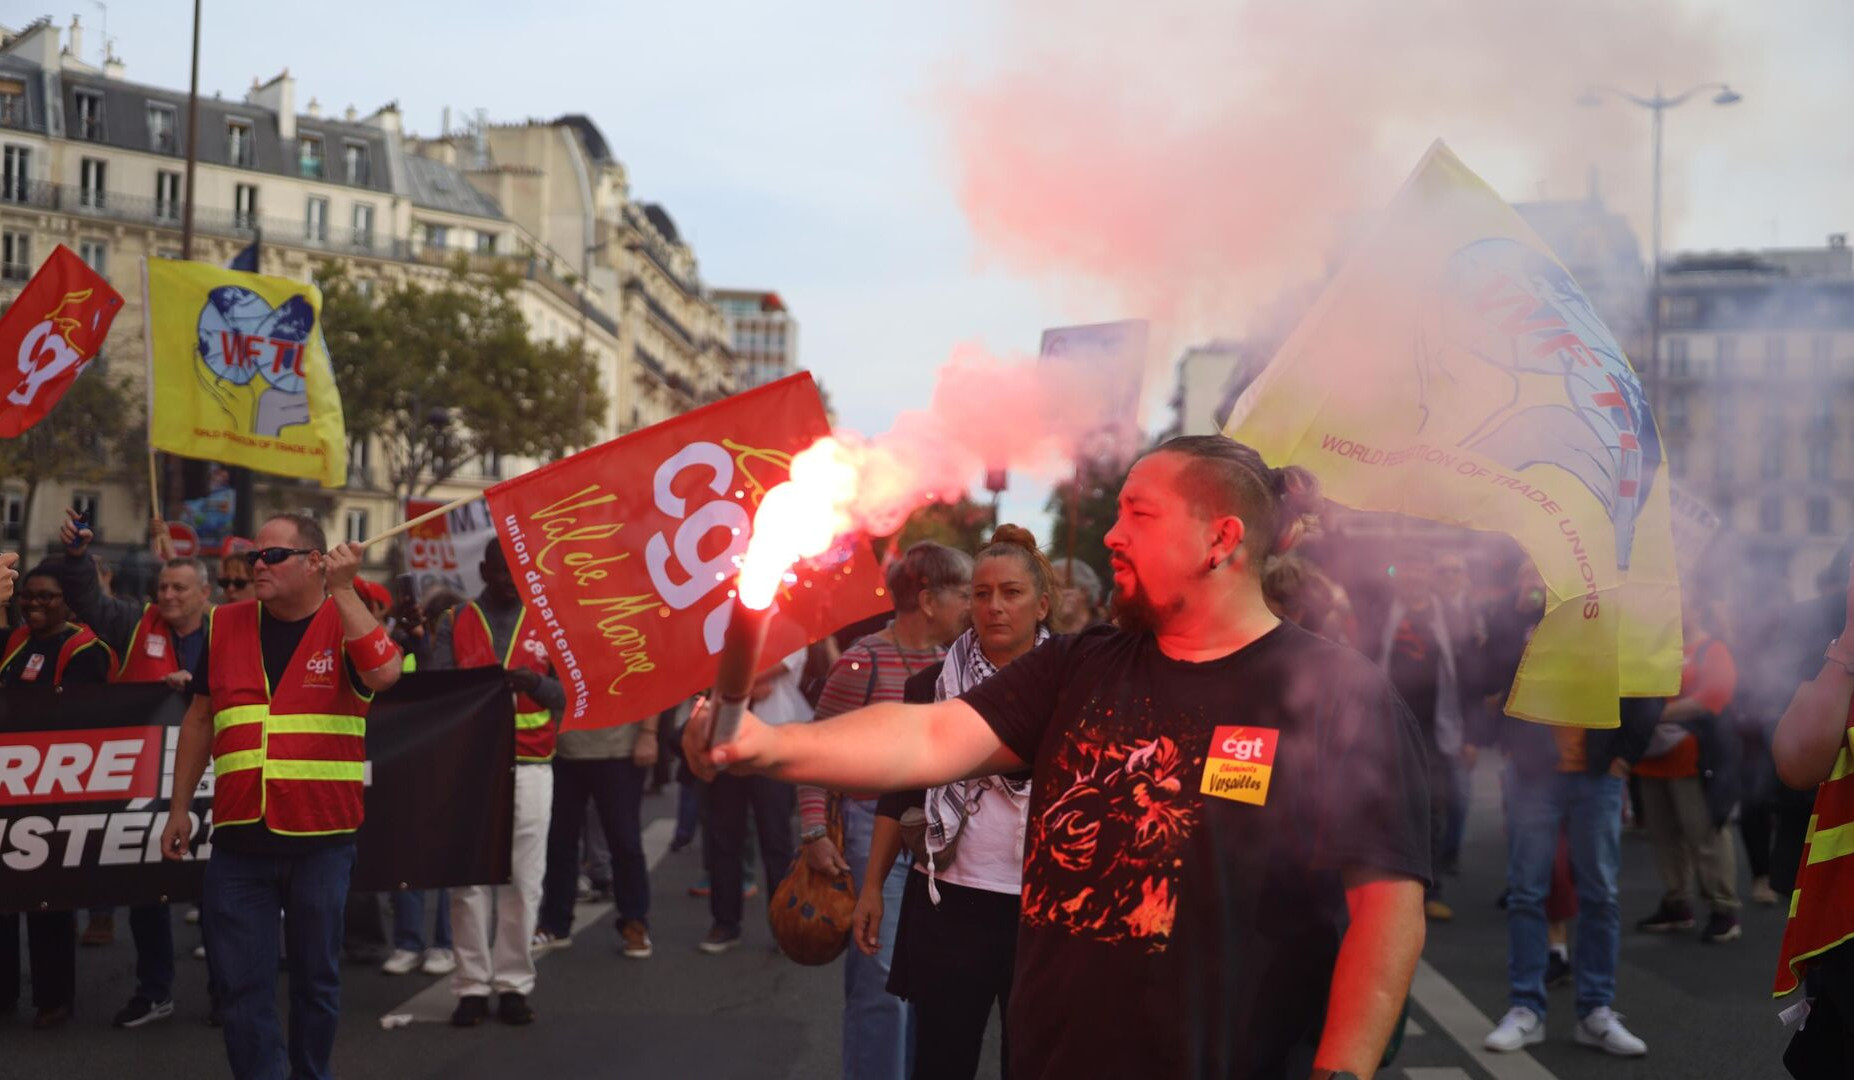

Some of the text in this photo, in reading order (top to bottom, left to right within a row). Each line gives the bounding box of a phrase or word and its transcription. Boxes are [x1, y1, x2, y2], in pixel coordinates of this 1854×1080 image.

[504, 513, 531, 566] union
[1321, 434, 1383, 465] WORLD
[1457, 461, 1491, 477] OF
[1490, 473, 1562, 516] TRADE
[1558, 518, 1600, 620] UNIONS
[530, 483, 664, 696] Val de Marne
[306, 654, 335, 675] cgt
[1222, 737, 1264, 760] cgt
[1209, 773, 1262, 793] Versailles
